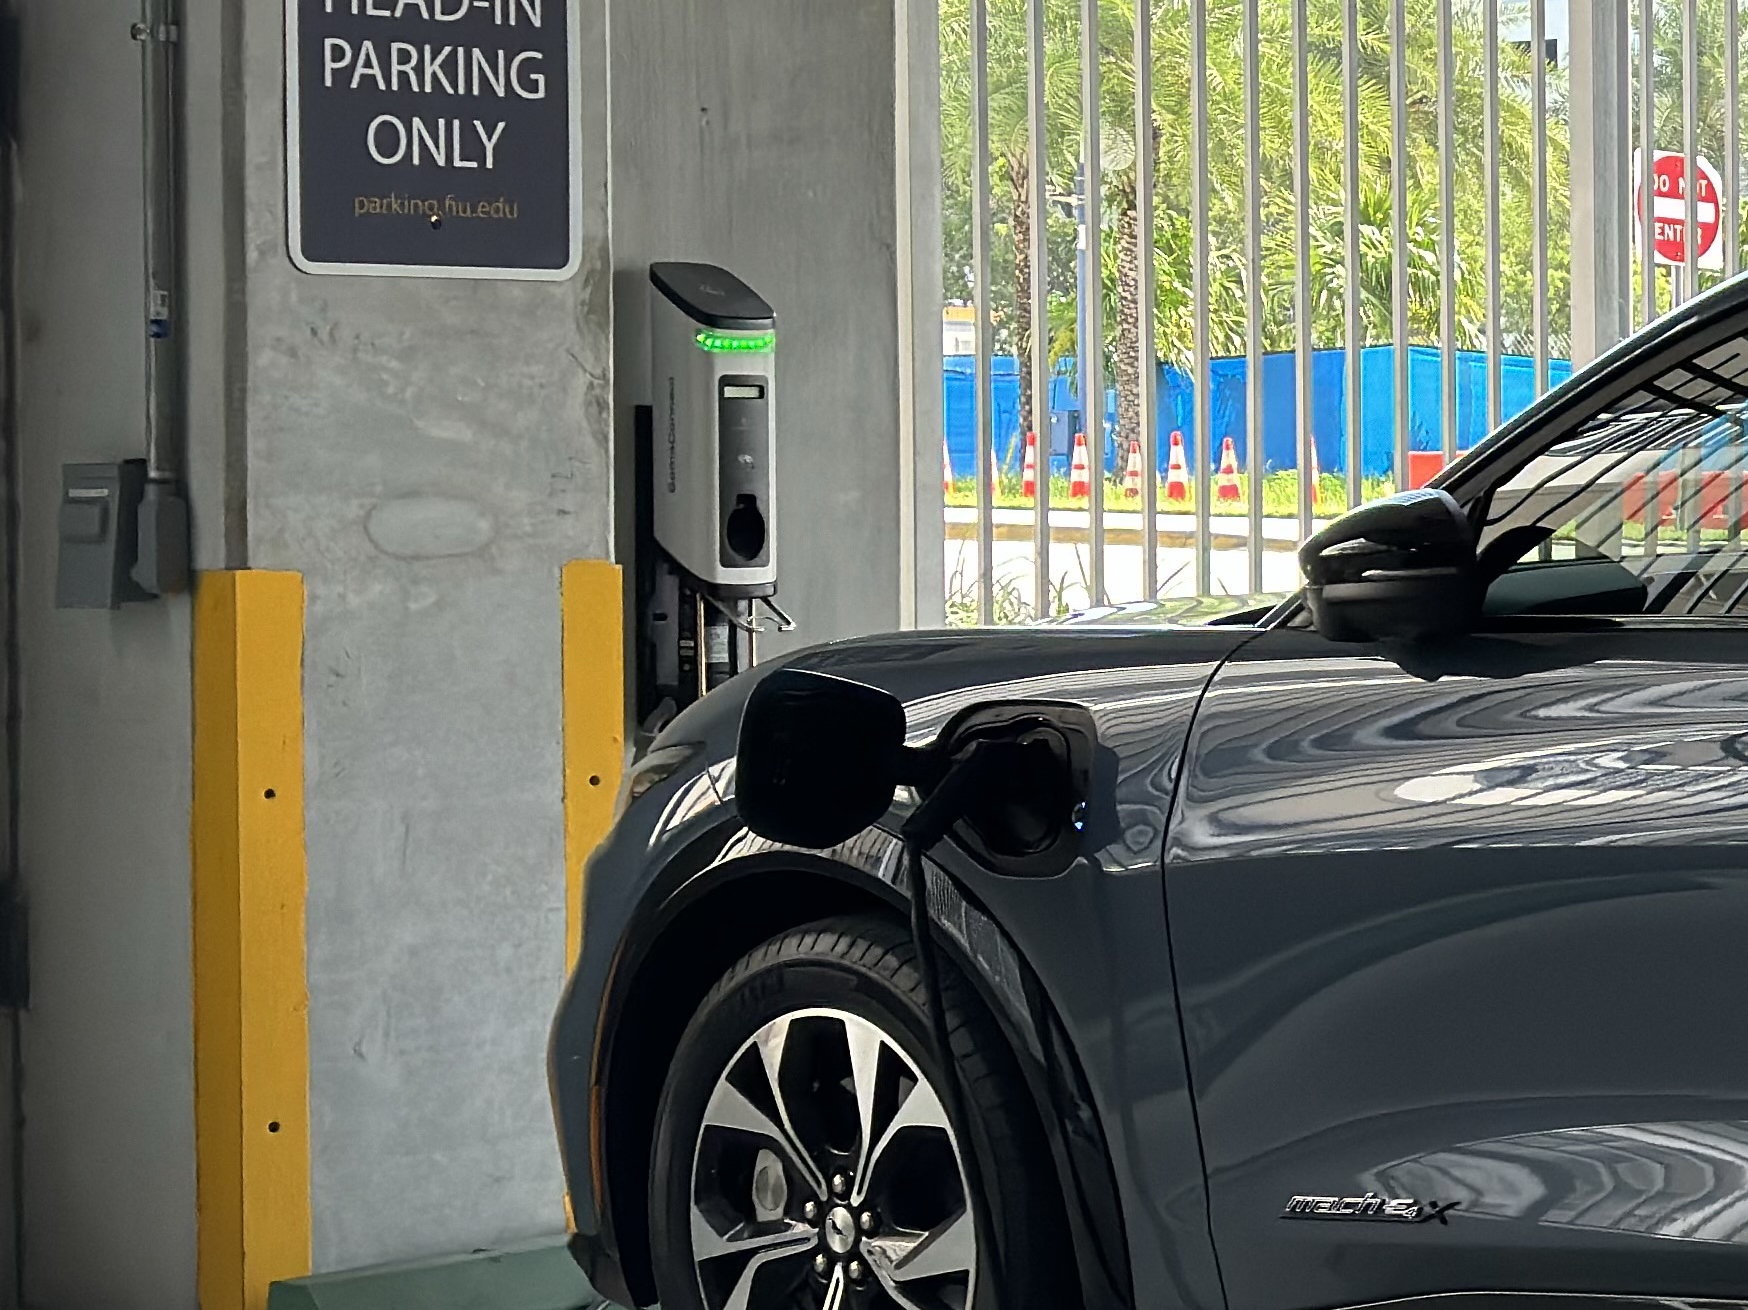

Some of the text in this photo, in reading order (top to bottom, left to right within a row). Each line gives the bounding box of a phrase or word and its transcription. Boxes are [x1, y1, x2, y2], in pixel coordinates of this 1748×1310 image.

[323, 37, 546, 99] PARKING
[367, 114, 506, 169] ONLY
[355, 192, 518, 219] parking.fiu.edu
[1678, 176, 1708, 197] NT
